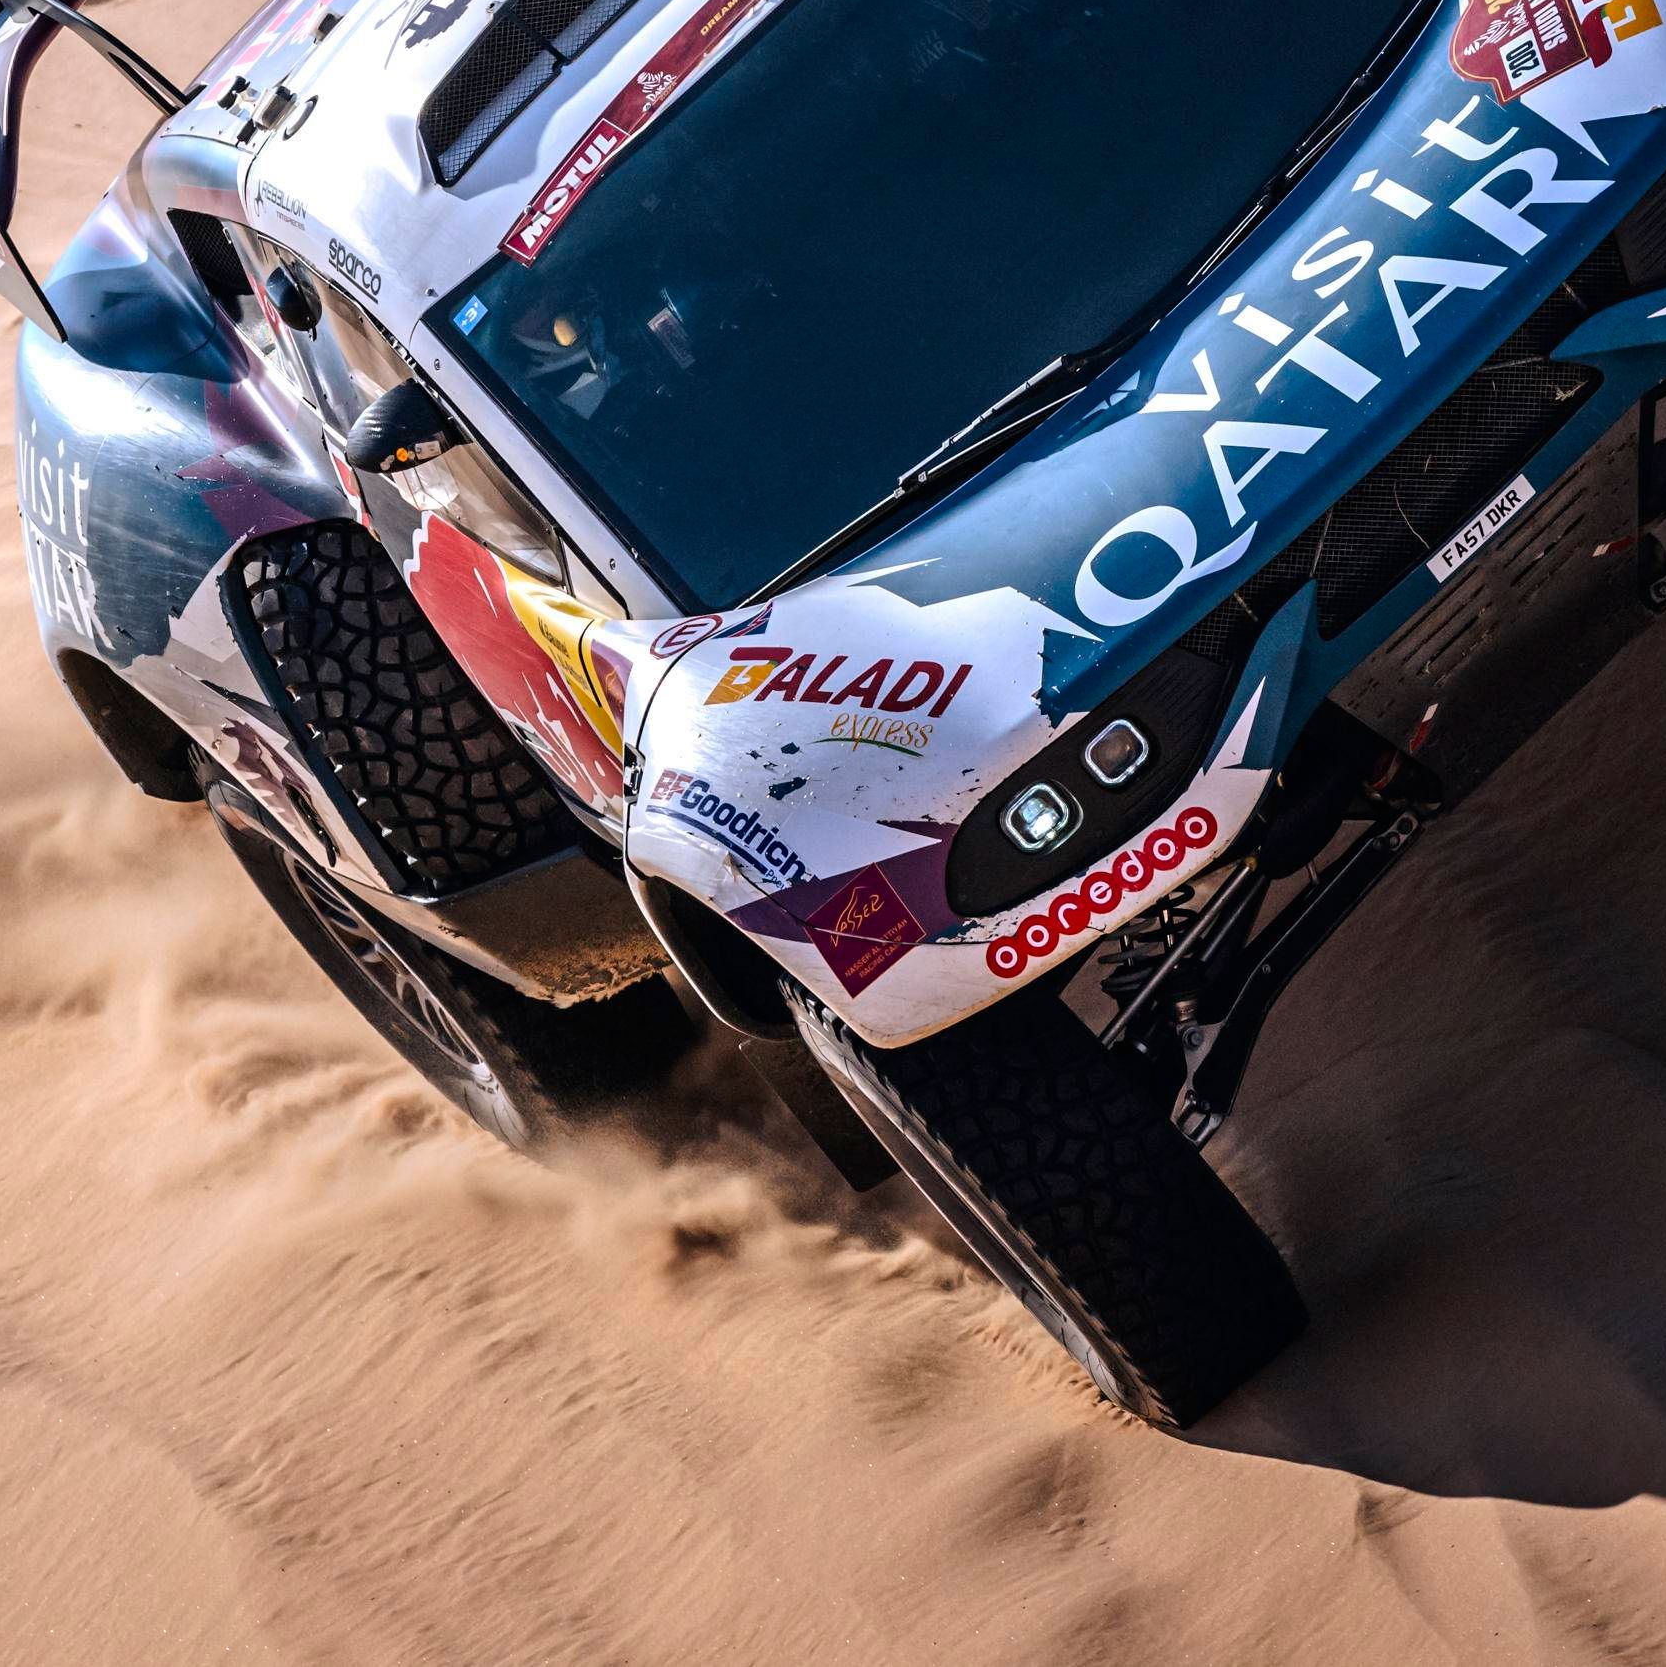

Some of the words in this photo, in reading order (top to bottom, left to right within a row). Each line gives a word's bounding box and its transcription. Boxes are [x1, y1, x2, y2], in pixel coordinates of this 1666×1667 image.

[1505, 39, 1540, 79] 200
[1533, 0, 1568, 52] SAUDI
[646, 73, 676, 102] DAKAR
[519, 133, 618, 249] MOTUL
[329, 237, 382, 297] sparco
[1137, 94, 1520, 415] visit
[1074, 146, 1617, 628] QATAR
[18, 417, 90, 547] visit
[1485, 489, 1522, 527] DKR
[704, 646, 974, 719] BALADI
[830, 712, 934, 752] express
[650, 767, 810, 885] BFGoodrich
[995, 822, 1208, 970] ooredoo
